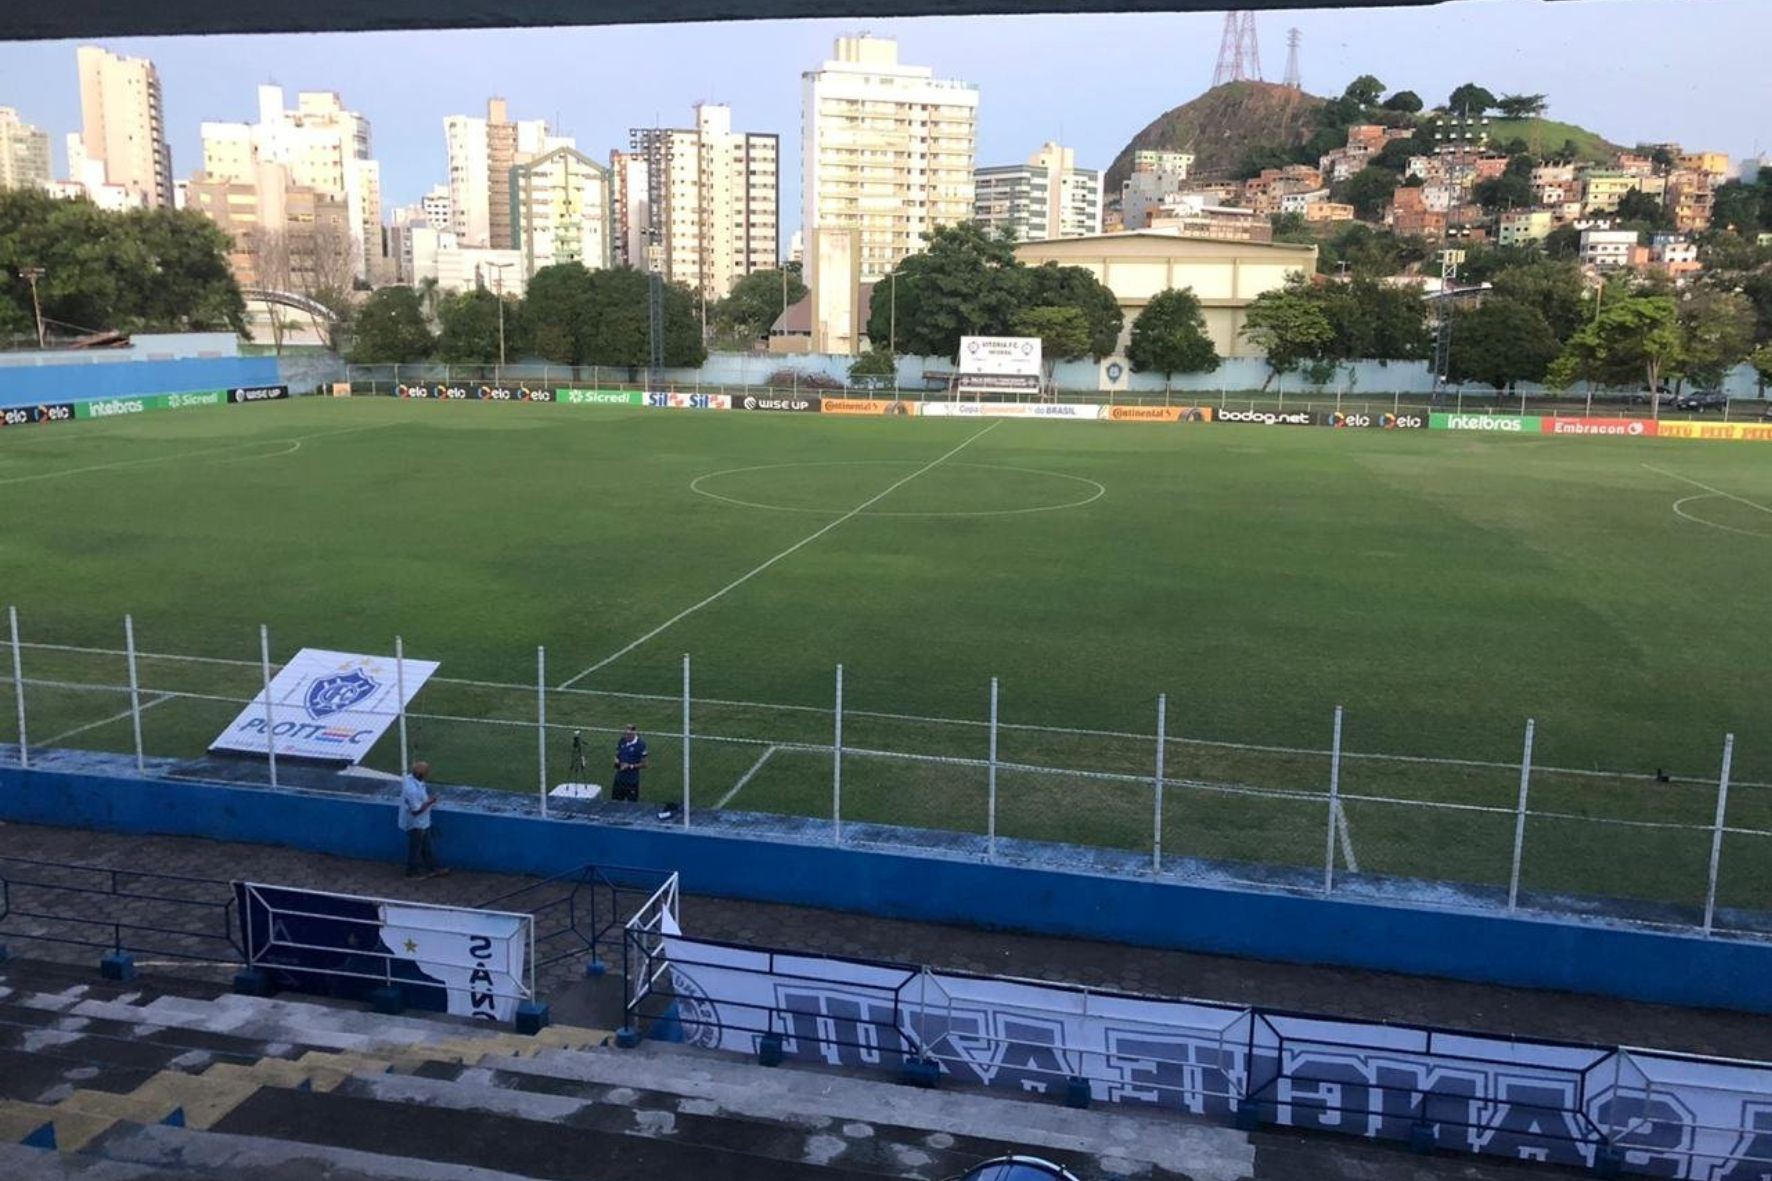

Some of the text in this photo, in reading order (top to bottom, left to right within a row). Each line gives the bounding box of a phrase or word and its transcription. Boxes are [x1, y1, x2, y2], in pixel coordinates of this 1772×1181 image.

[181, 392, 219, 406] Sicredi
[246, 388, 281, 399] WISE UP
[407, 386, 428, 399] elo
[447, 387, 467, 400] elo
[491, 388, 510, 401] elo
[530, 389, 551, 402] elo
[585, 391, 631, 405] Sicredi
[649, 393, 669, 407] Sil
[689, 394, 709, 409] Sil
[759, 399, 809, 411] WISE UP
[89, 400, 144, 418] intelbras
[1046, 406, 1076, 415] BRASIL
[1112, 407, 1164, 419] Continental
[1218, 408, 1310, 425] bodog.net
[1346, 414, 1370, 427] elo
[1397, 415, 1421, 428] elo
[1447, 414, 1522, 431] intelbras
[1554, 420, 1625, 434] Embracon
